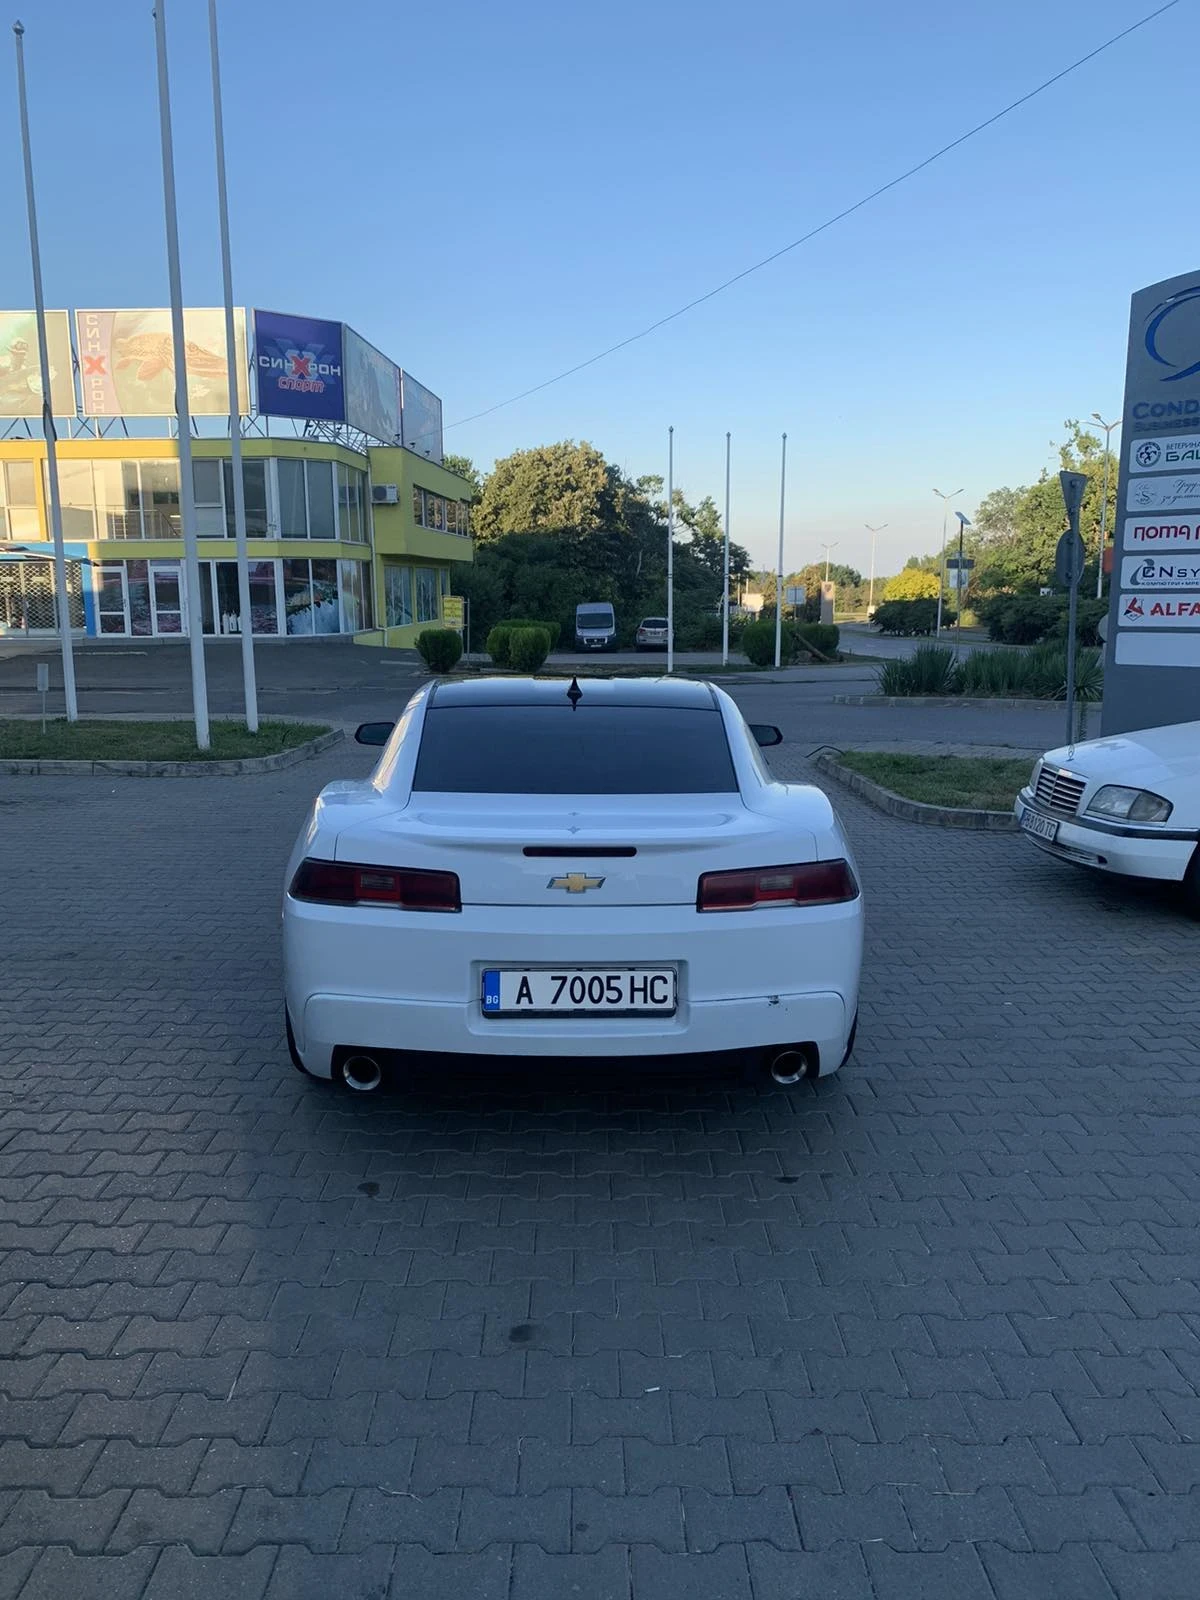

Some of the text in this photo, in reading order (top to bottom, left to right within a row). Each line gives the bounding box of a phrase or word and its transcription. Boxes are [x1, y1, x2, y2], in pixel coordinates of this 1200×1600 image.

[258, 354, 341, 378] СИНХРОН
[486, 995, 499, 1005] BG
[516, 975, 668, 1005] A 7005 HC
